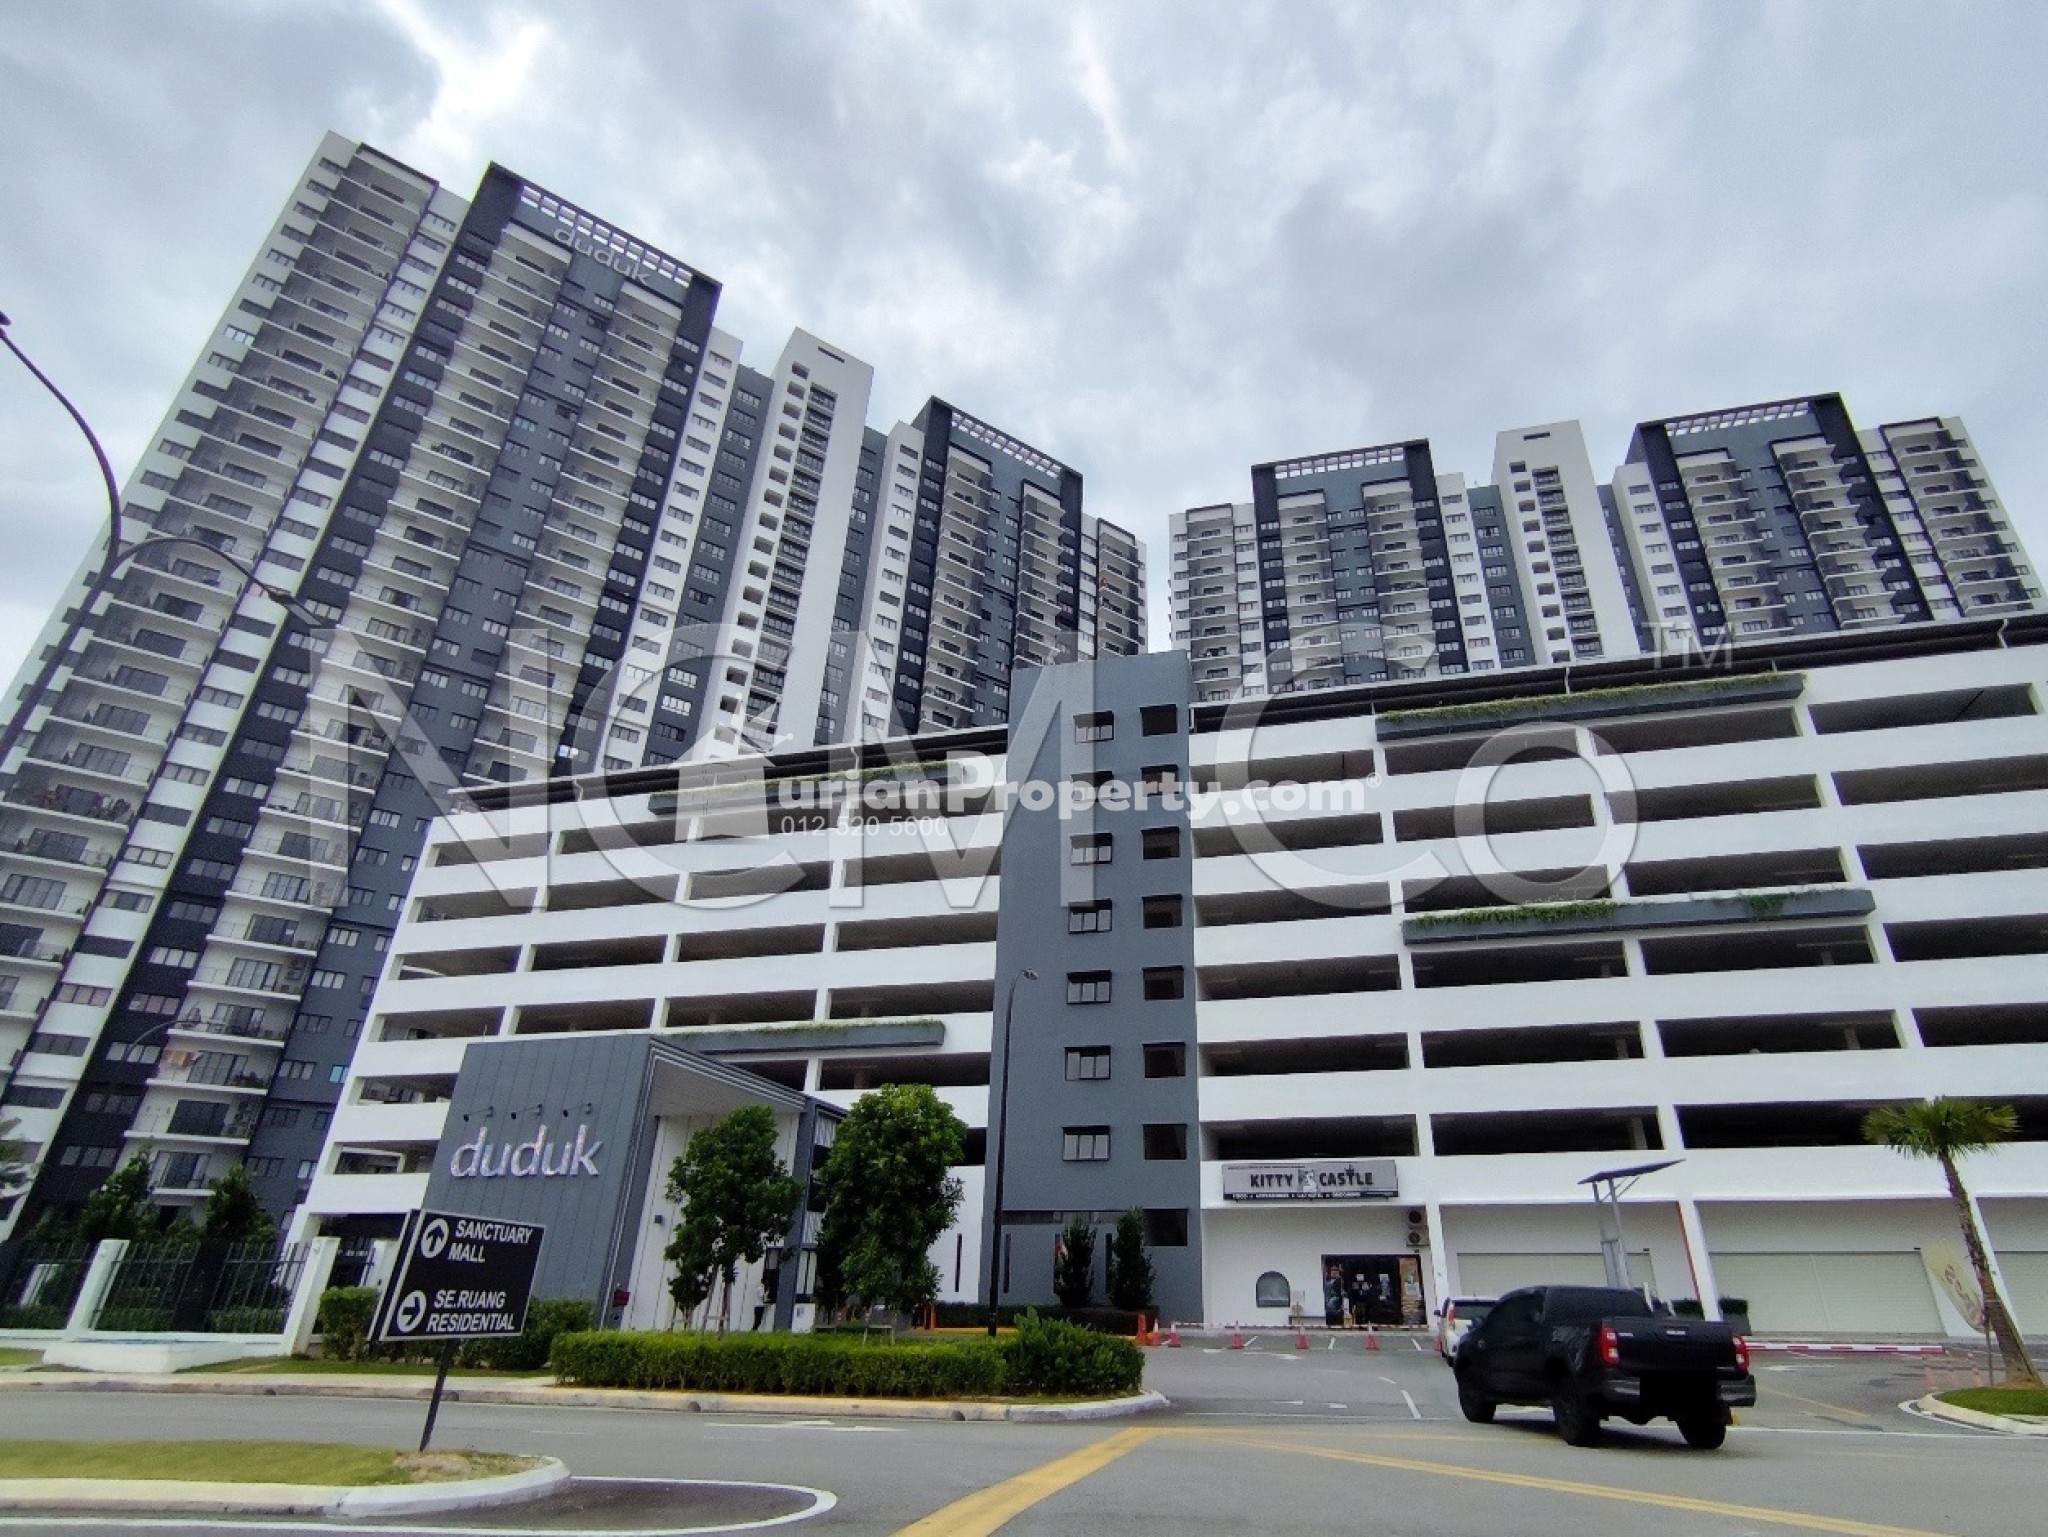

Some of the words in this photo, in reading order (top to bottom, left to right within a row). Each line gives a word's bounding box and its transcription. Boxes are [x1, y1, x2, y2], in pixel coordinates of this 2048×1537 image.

[554, 226, 650, 285] duduk
[450, 1124, 602, 1178] duduk
[1250, 1173, 1293, 1188] KITTY
[1319, 1170, 1374, 1187] CASTLE
[455, 1219, 533, 1244] SANCTUARY
[447, 1242, 486, 1263] MALL
[433, 1289, 507, 1309] SE.RUANG
[425, 1312, 516, 1333] RESIDENTIAL
